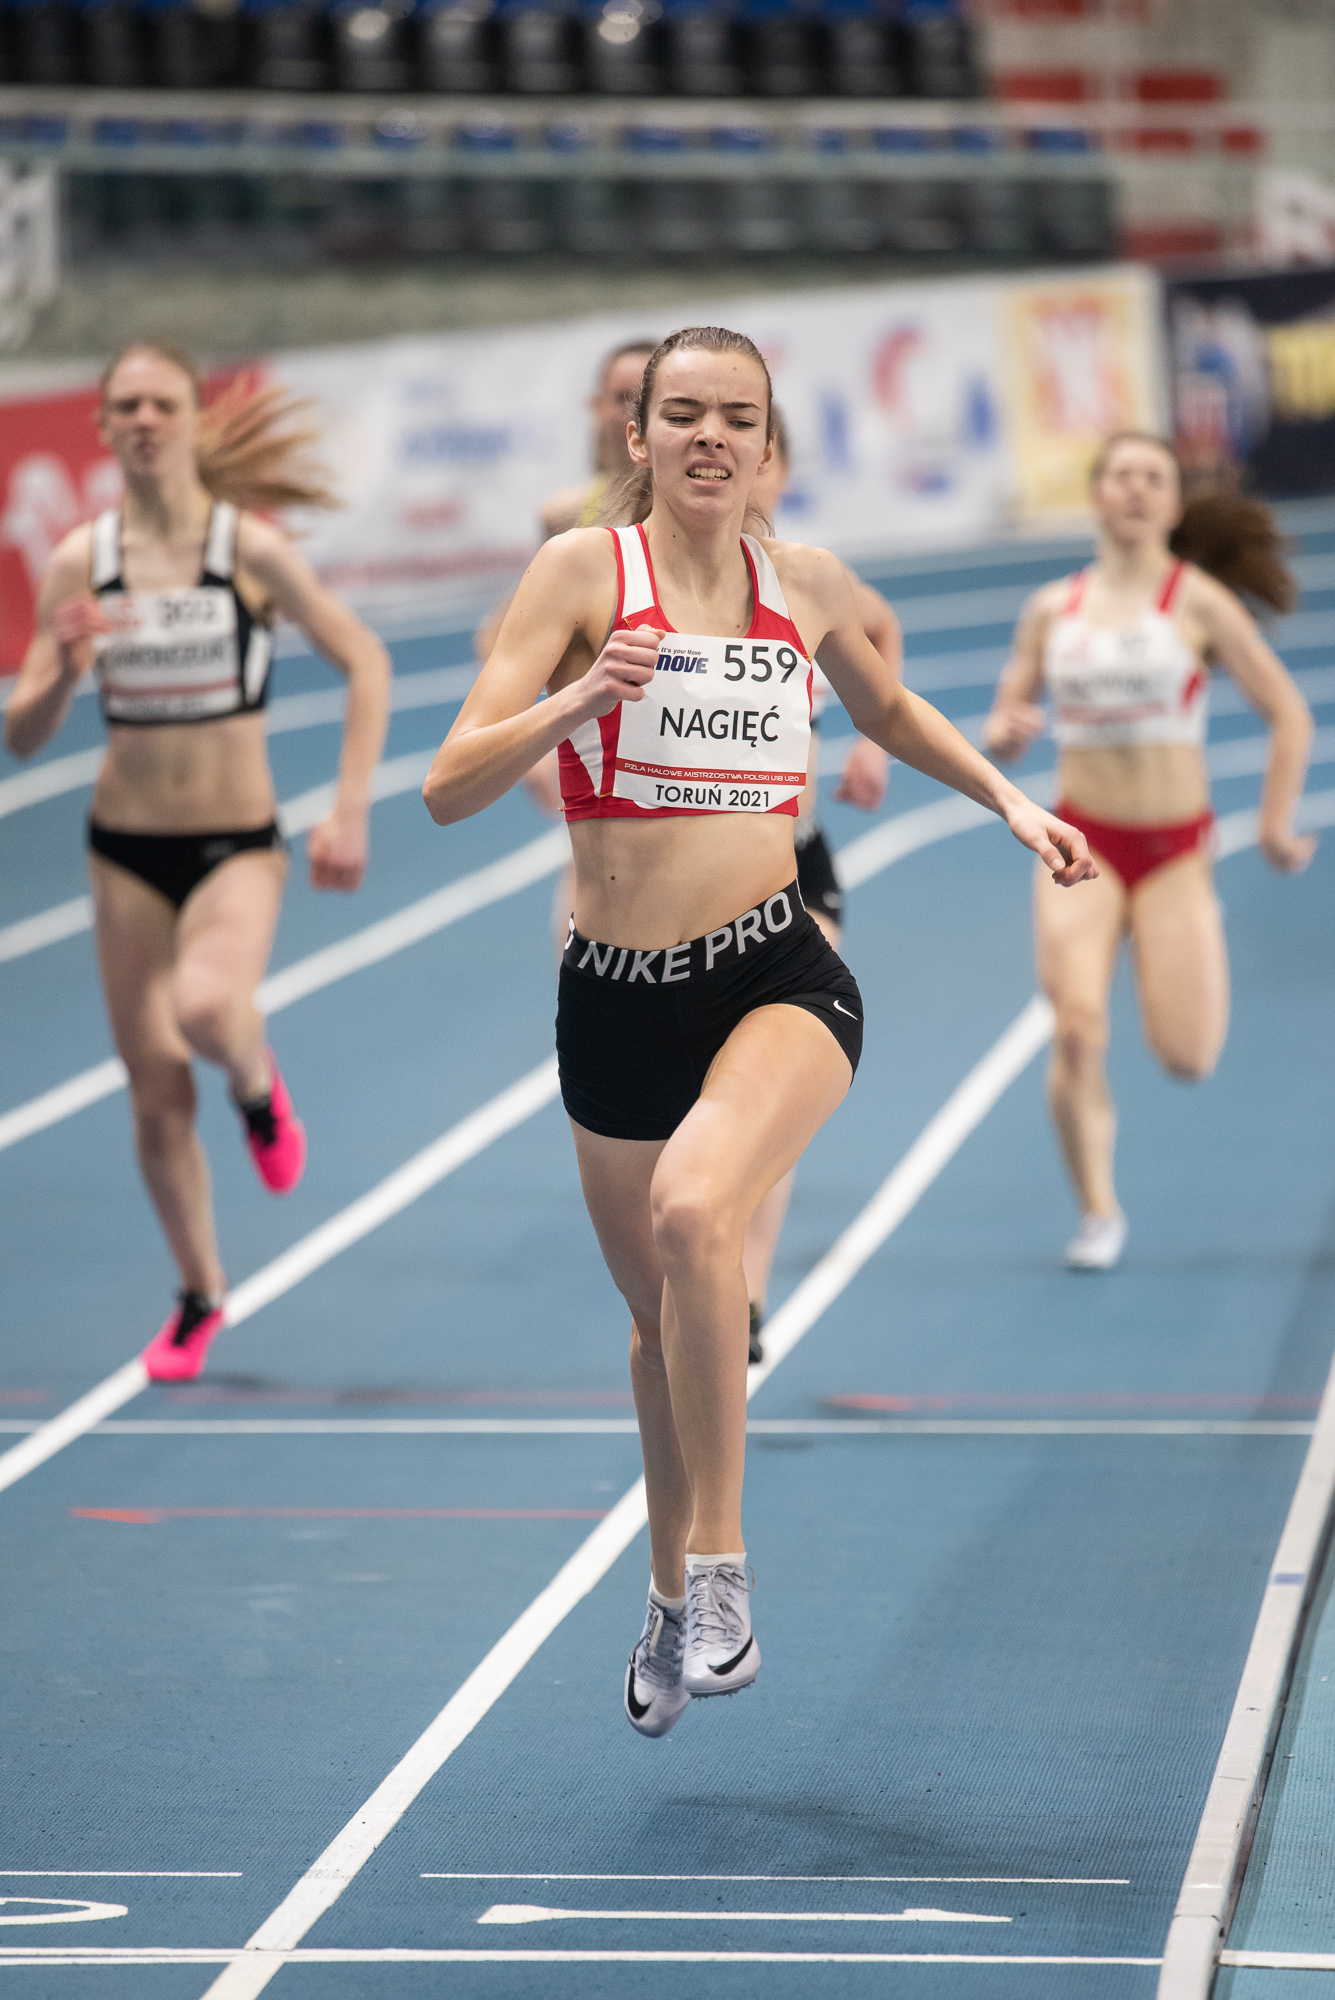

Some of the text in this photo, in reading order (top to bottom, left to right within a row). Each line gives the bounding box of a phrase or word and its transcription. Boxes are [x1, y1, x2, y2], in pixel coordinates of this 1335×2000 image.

[724, 645, 797, 683] 559
[660, 705, 780, 747] NAGIĘĆ
[624, 762, 646, 772] PZLA
[647, 767, 682, 777] HALOWE
[684, 771, 742, 780] MISTRZOSTWA
[655, 783, 769, 808] TORUŃ 2021
[577, 891, 793, 984] NIKE PRO
